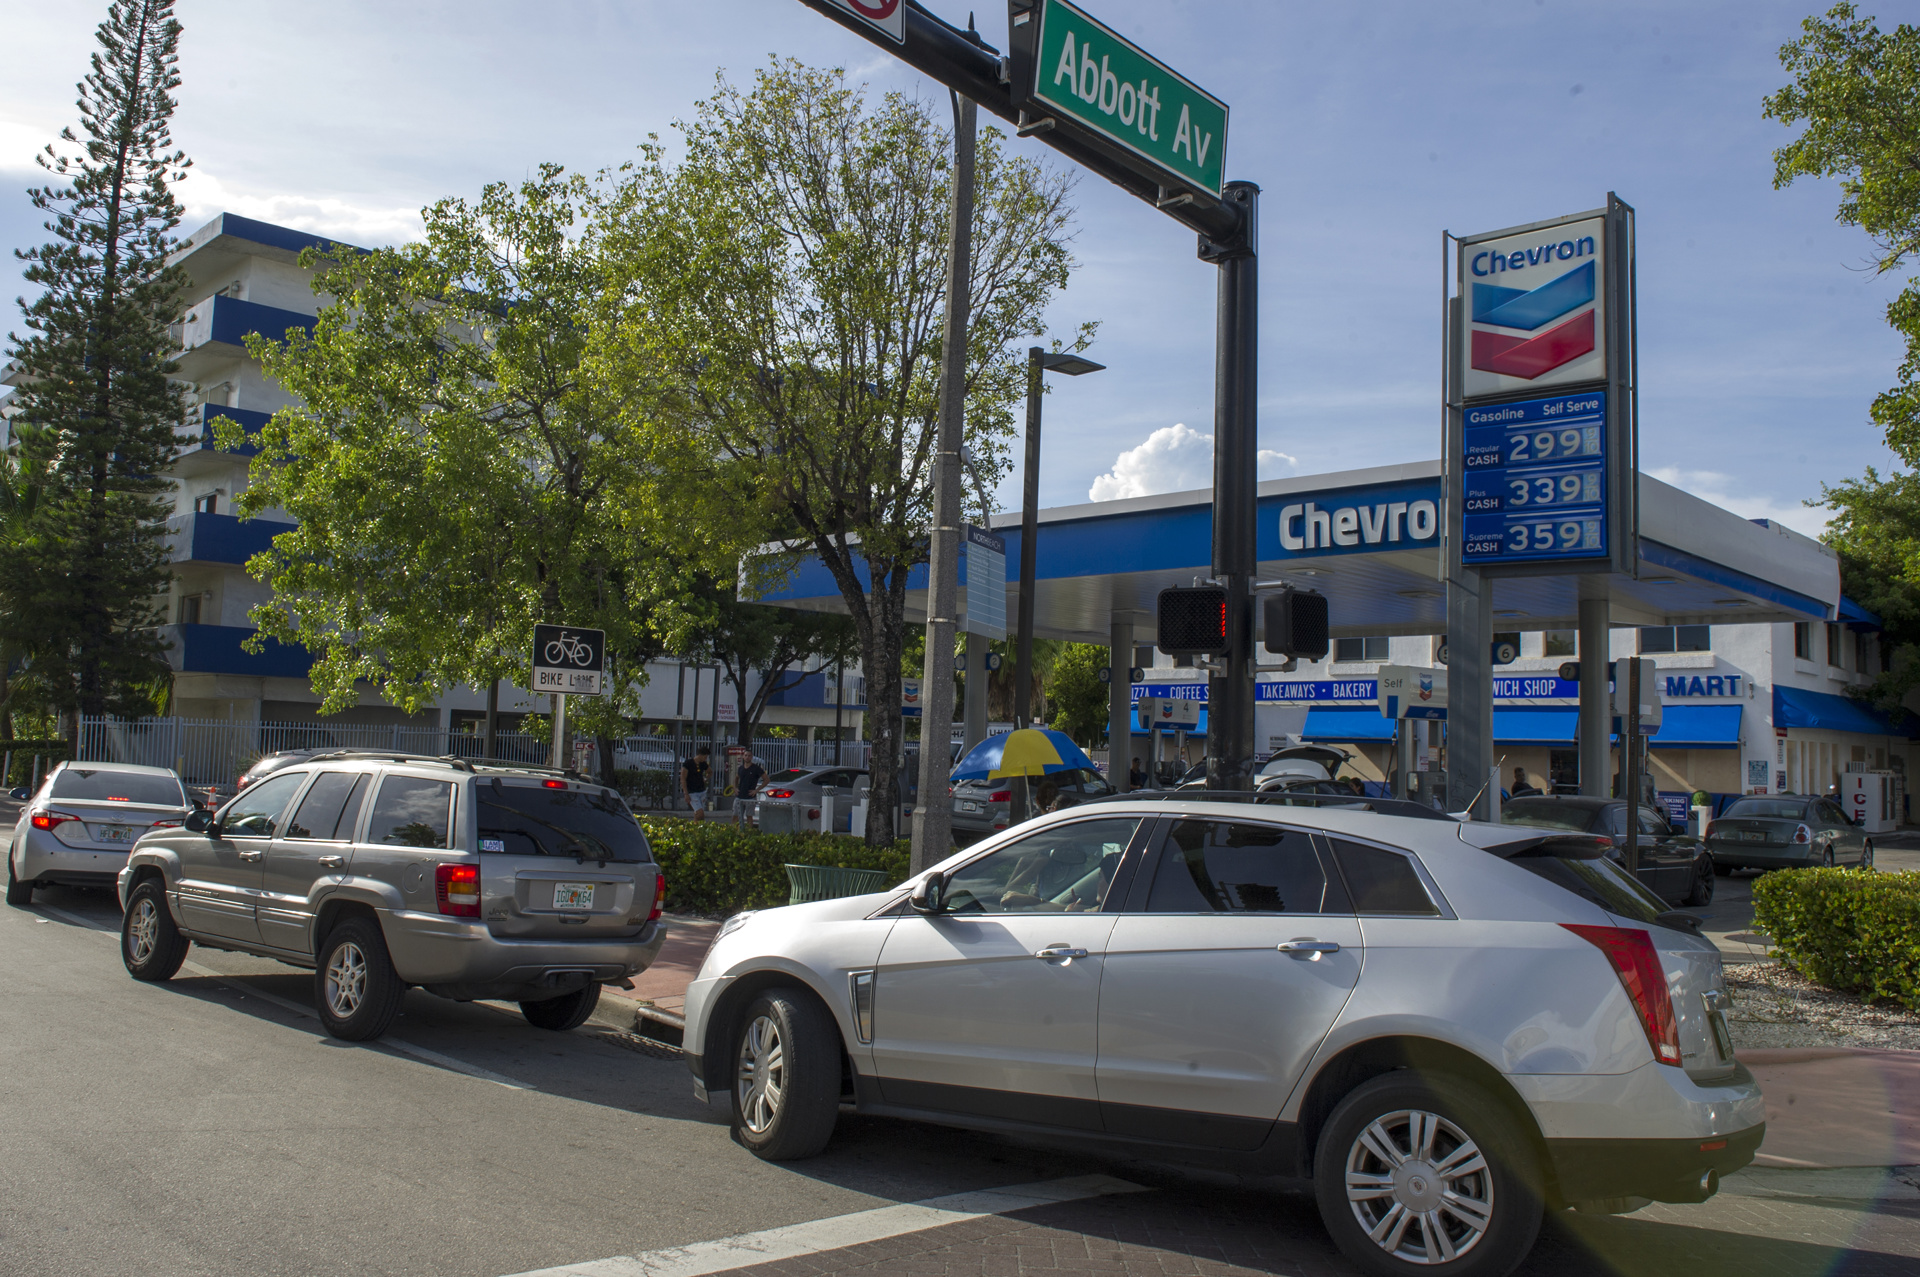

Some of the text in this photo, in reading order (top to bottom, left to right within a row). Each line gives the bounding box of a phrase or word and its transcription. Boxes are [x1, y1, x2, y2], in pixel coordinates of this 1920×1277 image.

[1054, 31, 1211, 168] Abbott Av
[1471, 236, 1595, 277] Chevron
[1470, 400, 1599, 423] Gasoline Self Serve
[1469, 444, 1500, 454] Regular
[1509, 429, 1581, 461] 299
[1467, 454, 1499, 466] CASH
[1469, 489, 1486, 497] Plus
[1509, 475, 1581, 506] 339
[1467, 498, 1498, 510] CASH
[1279, 500, 1437, 550] Chevro
[1468, 533, 1503, 542] Supreme
[1508, 522, 1580, 551] 359
[1466, 542, 1498, 553] CASH
[1501, 648, 1510, 659] 6
[992, 657, 998, 666] 2
[1564, 667, 1572, 677] 7
[540, 672, 563, 686] BIKE
[1384, 678, 1403, 688] Self
[1262, 682, 1372, 699] TAKEAWAYS BAKERY
[1493, 679, 1556, 696] WICH SHOP
[1665, 675, 1742, 697] MART
[1131, 687, 1150, 700] IZZA
[1170, 686, 1201, 699] COFFEE
[1183, 702, 1189, 712] 4
[577, 891, 592, 903] K64
